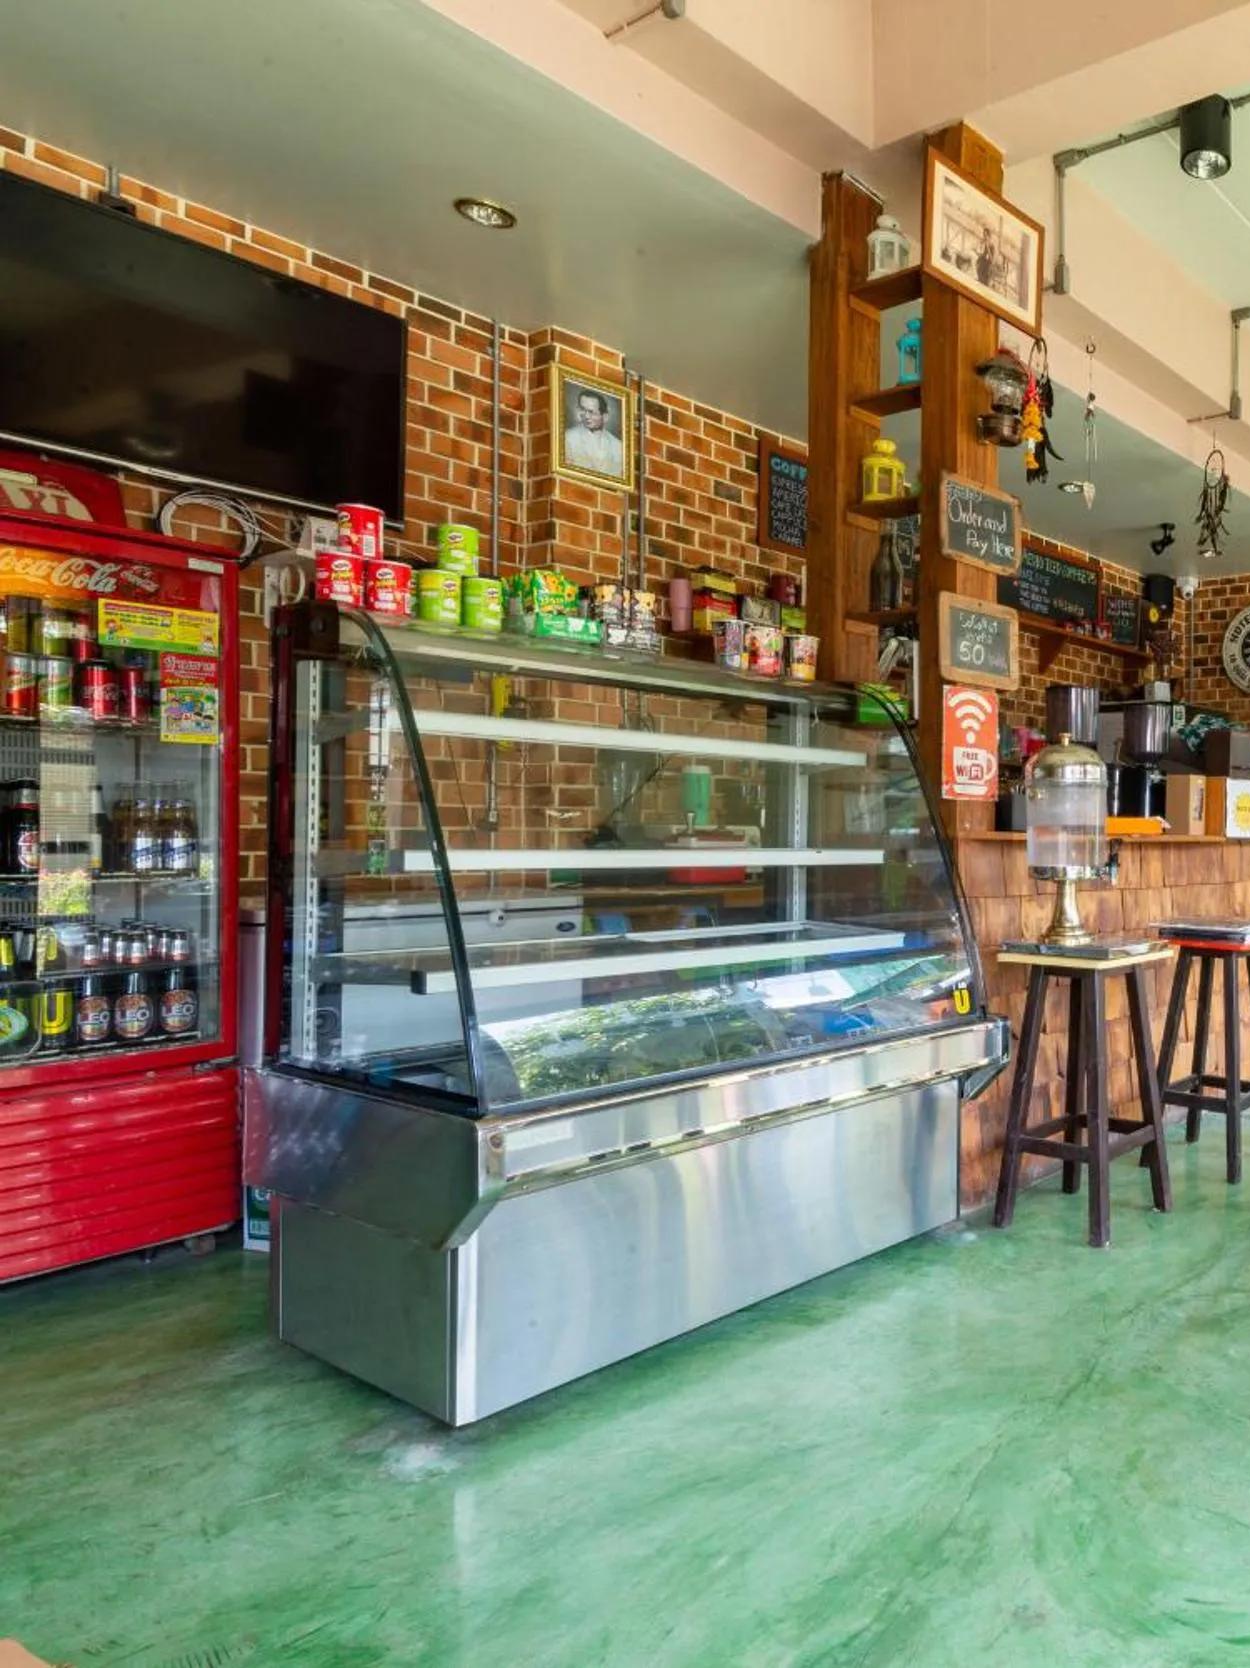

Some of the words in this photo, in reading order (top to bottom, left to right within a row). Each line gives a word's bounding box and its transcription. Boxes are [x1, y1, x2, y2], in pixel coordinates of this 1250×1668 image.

[948, 496, 982, 527] Order
[984, 510, 1008, 534] and
[966, 529, 988, 557] Pay
[991, 532, 1015, 559] Here
[959, 640, 984, 665] 50
[78, 1010, 110, 1024] LEO
[116, 1008, 150, 1022] LEO
[161, 1003, 194, 1018] LEO
